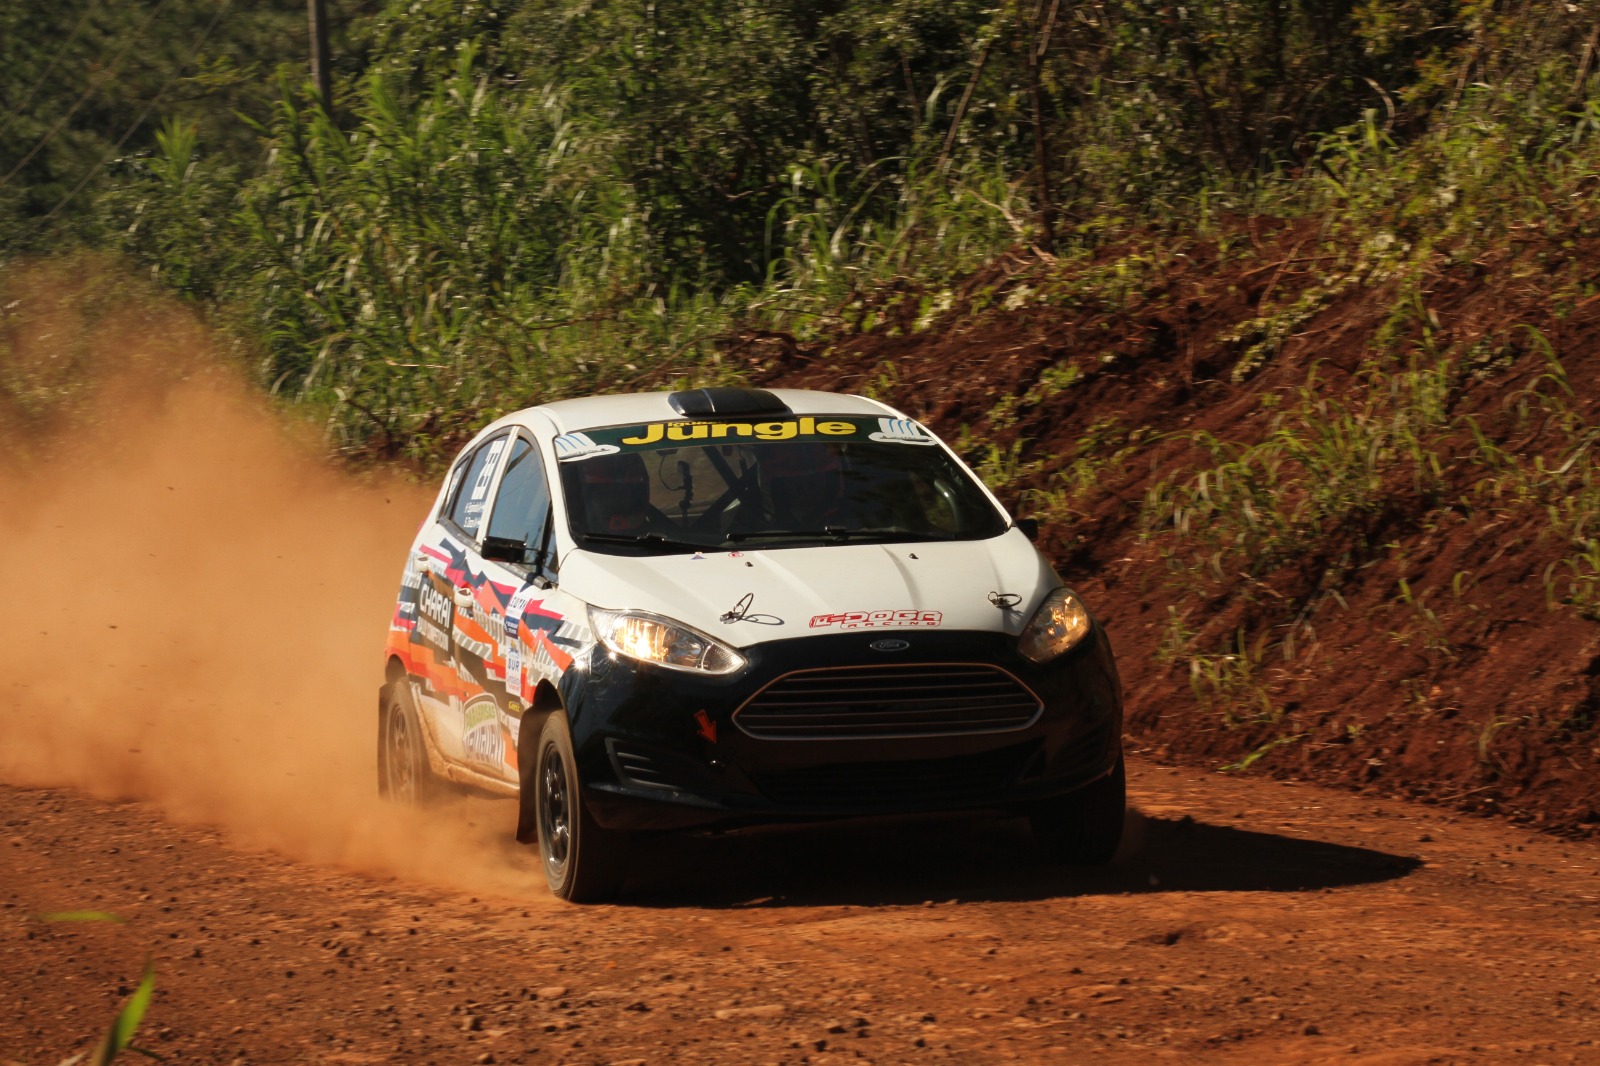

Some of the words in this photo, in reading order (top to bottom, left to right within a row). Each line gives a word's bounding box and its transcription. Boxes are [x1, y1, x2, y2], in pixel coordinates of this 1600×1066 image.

[621, 417, 857, 445] Jungle
[419, 584, 452, 629] CHARAI
[879, 640, 900, 650] Ford
